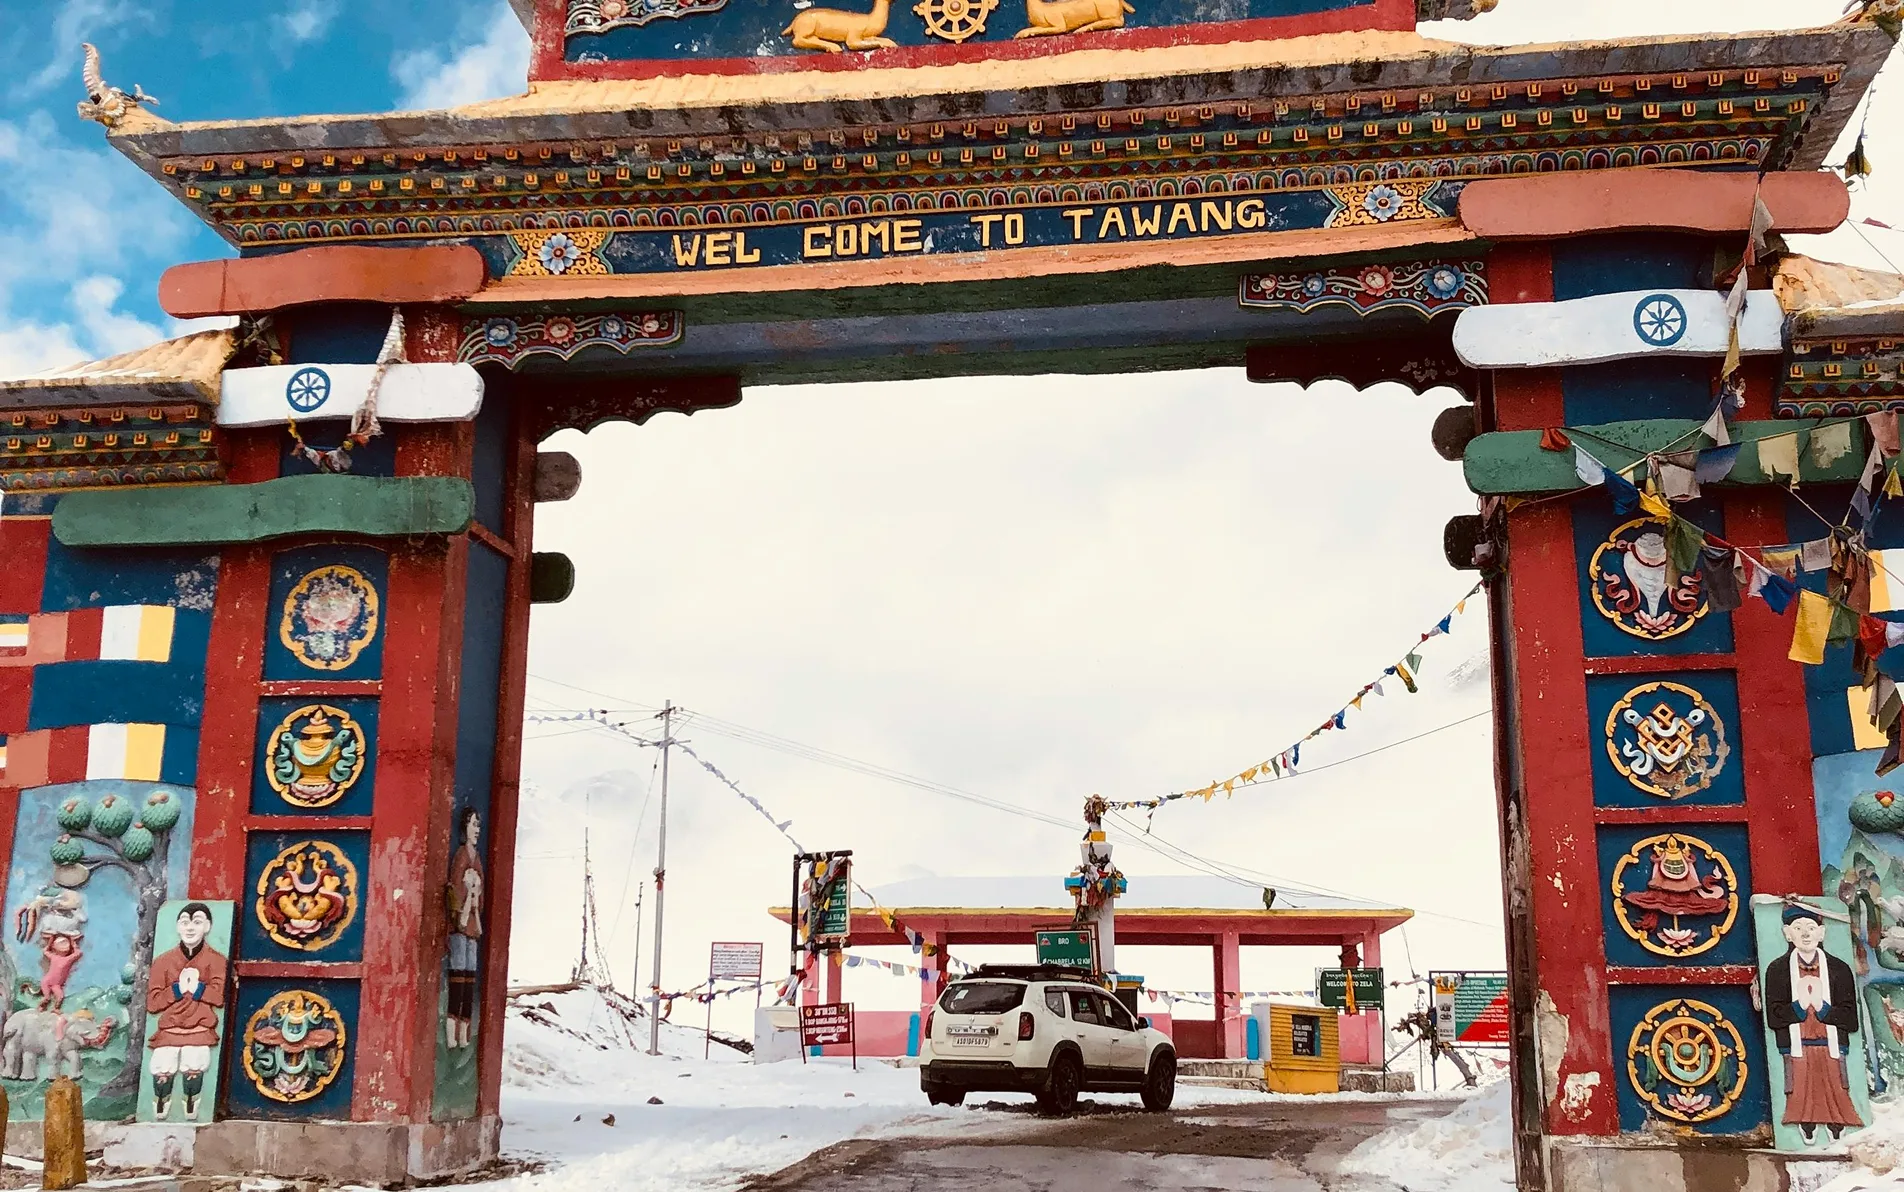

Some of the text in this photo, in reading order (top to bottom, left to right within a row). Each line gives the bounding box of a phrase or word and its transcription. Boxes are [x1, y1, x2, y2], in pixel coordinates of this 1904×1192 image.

[671, 198, 1268, 268] WEL COME TO TAWANG
[1057, 937, 1070, 945] BRO
